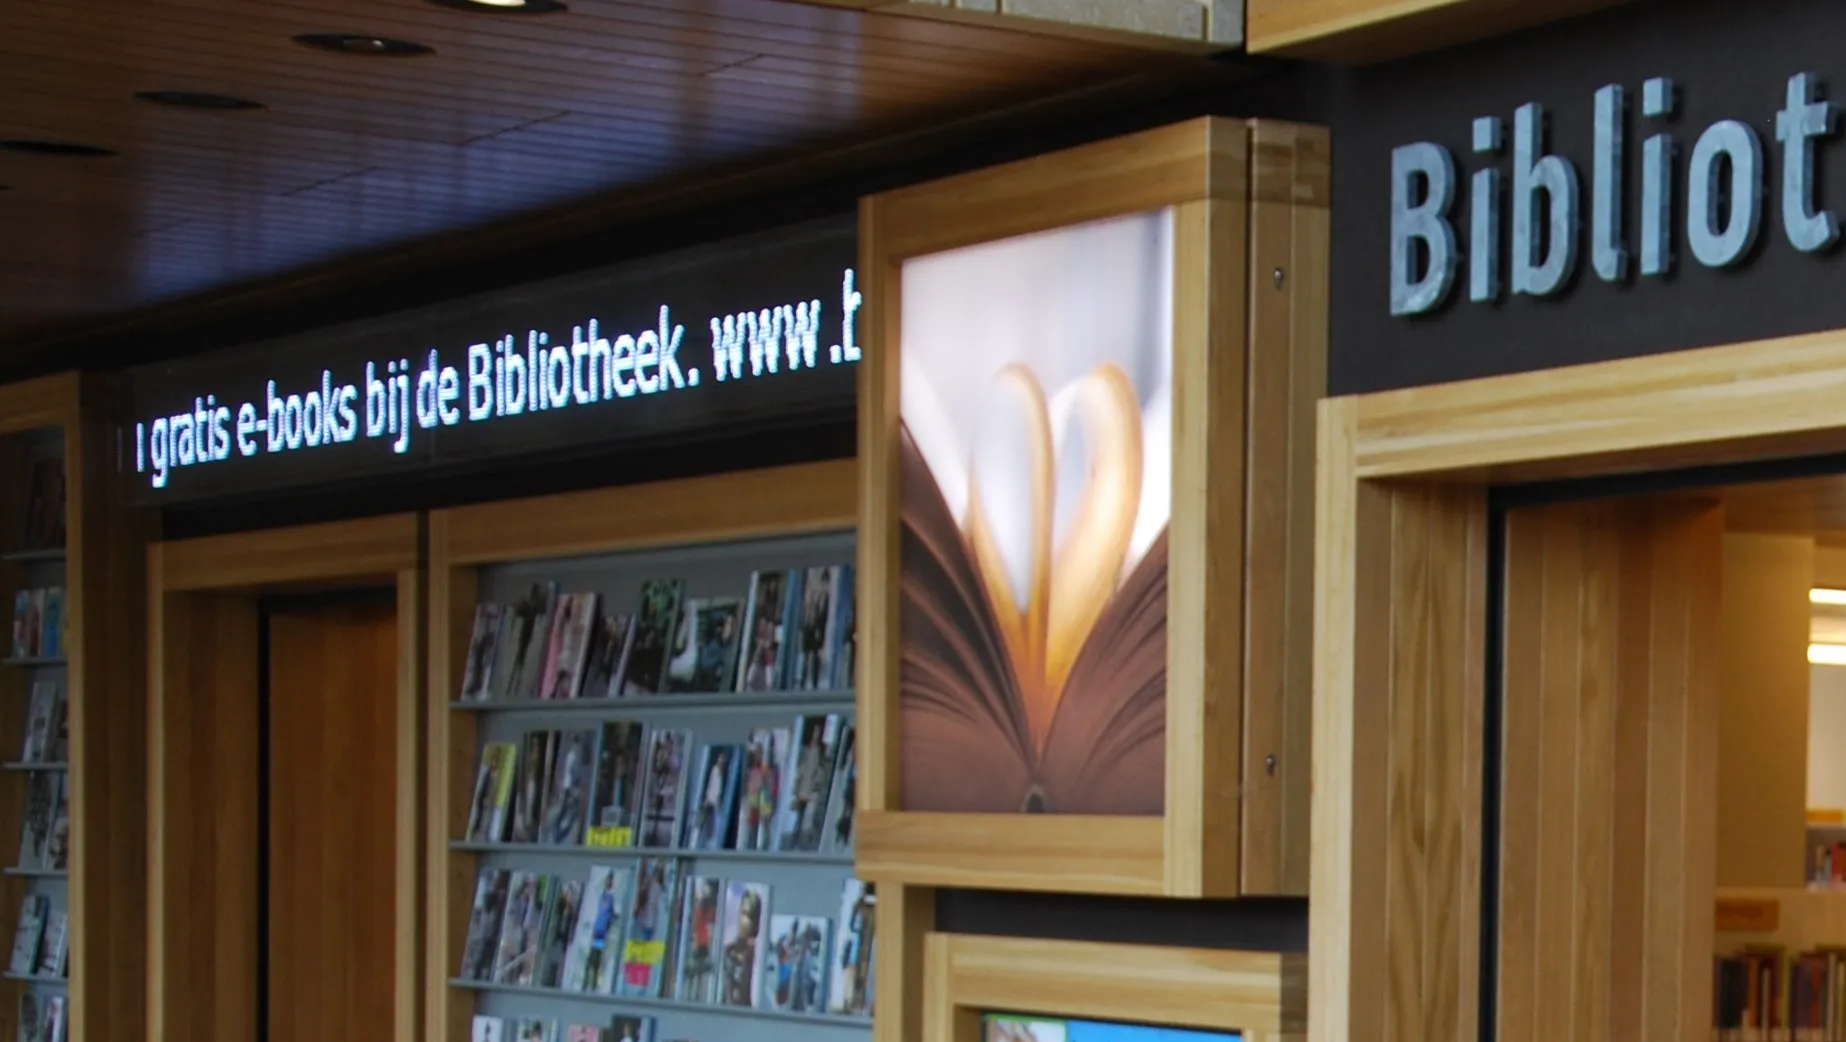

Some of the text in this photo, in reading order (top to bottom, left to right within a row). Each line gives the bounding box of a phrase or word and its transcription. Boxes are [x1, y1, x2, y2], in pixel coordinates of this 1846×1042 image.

[151, 394, 231, 488] gratis
[236, 372, 357, 457] e-books
[366, 358, 409, 453] bij
[416, 349, 459, 428] de
[468, 305, 700, 421] Bibliotheek.
